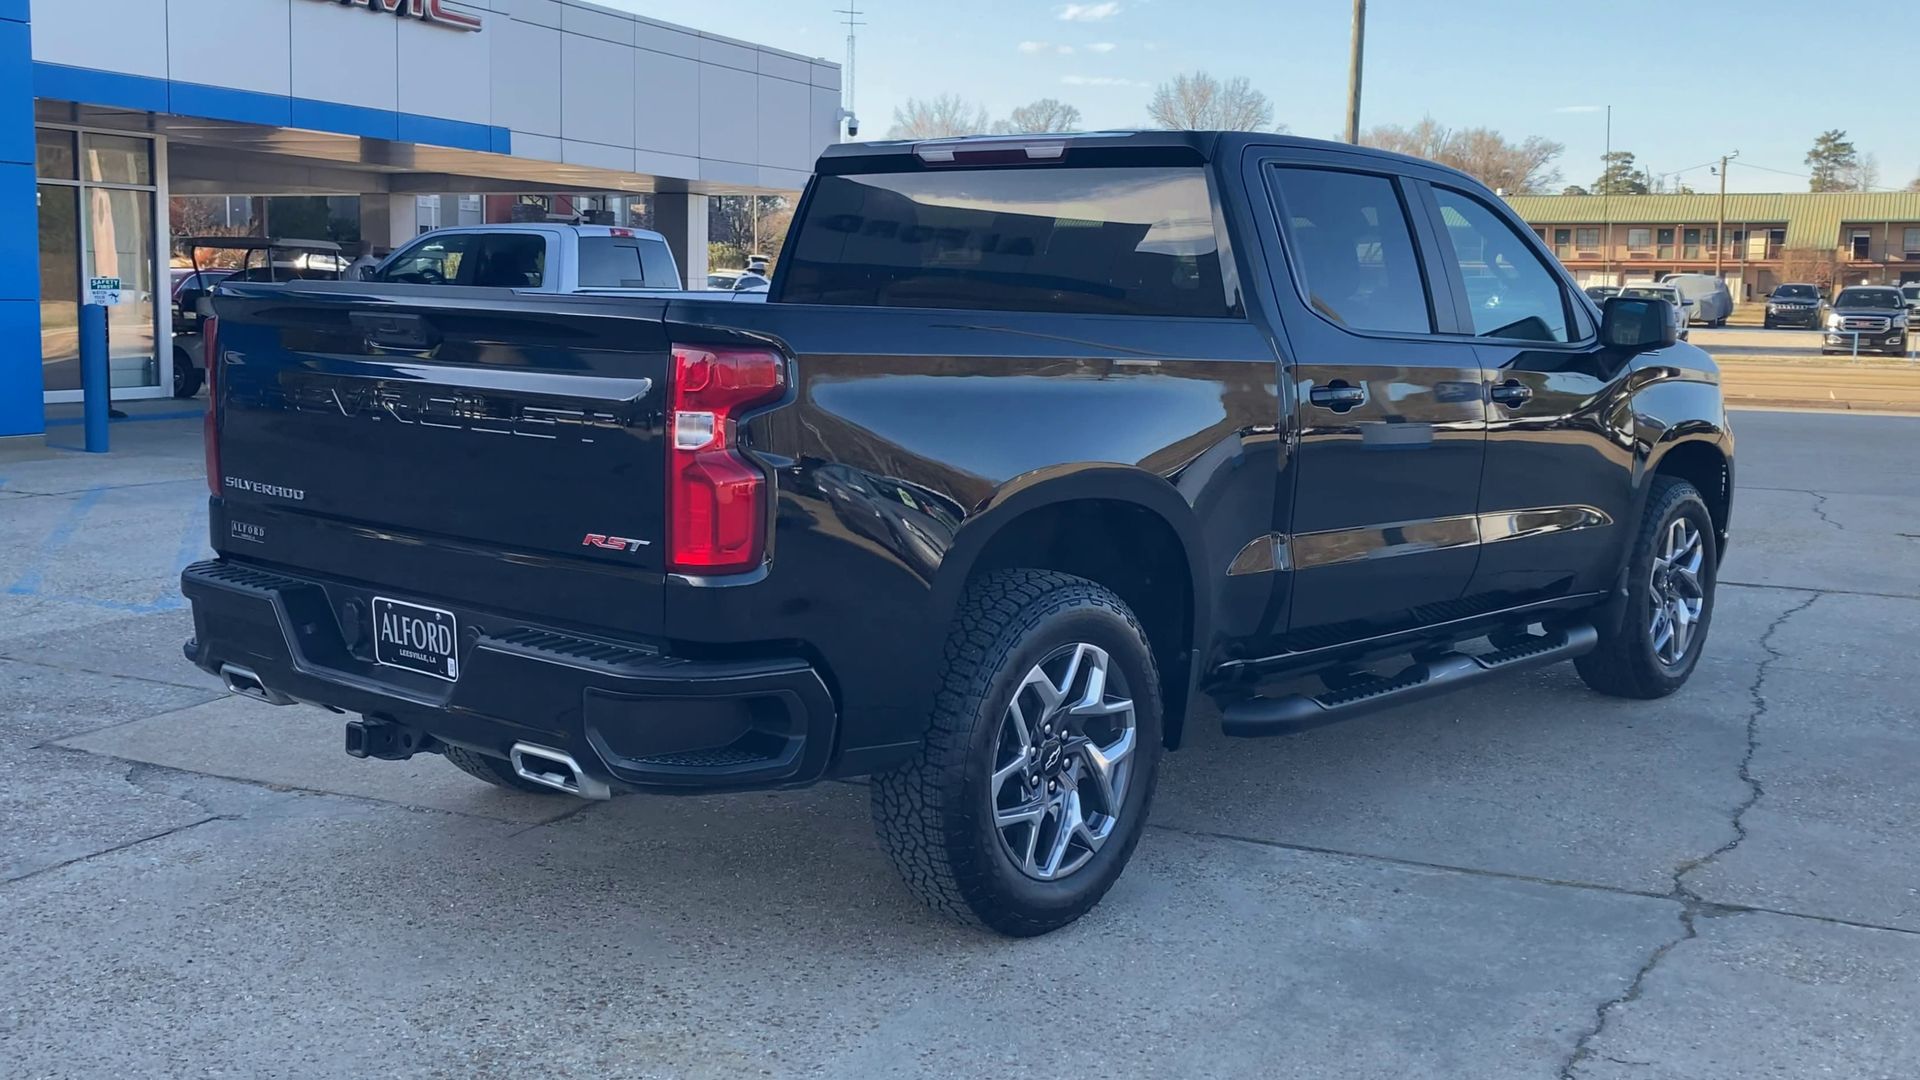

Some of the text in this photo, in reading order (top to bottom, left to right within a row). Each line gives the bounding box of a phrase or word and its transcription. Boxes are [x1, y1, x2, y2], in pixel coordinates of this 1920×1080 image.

[228, 384, 615, 443] EVROLET
[225, 476, 304, 500] SILVERADO
[233, 522, 264, 537] ALFORD
[582, 533, 651, 552] RST
[381, 612, 451, 656] ALFORD
[400, 649, 436, 664] LEESVILLE, LA
